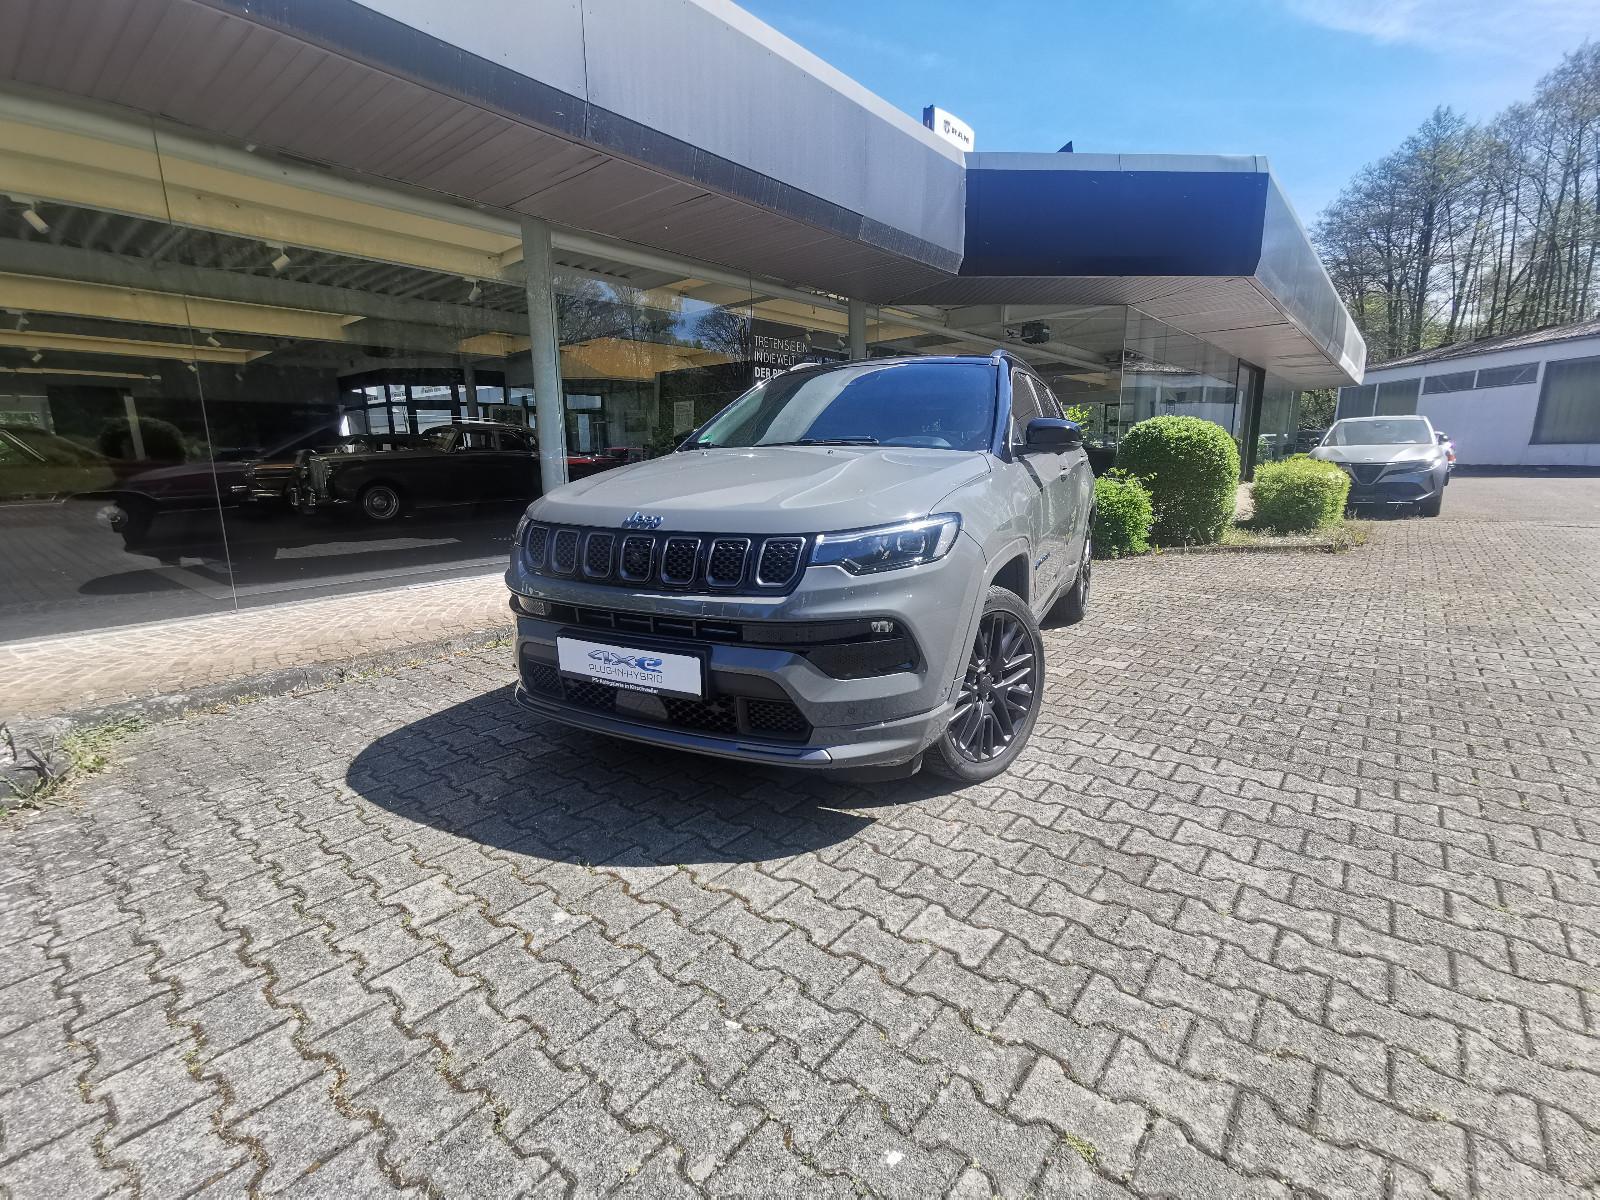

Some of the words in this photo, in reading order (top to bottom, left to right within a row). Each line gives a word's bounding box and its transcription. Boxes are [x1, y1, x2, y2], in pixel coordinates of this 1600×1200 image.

[952, 127, 969, 144] RAM
[754, 350, 763, 363] IN
[763, 352, 776, 364] DIE
[777, 354, 796, 366] WELT
[754, 366, 771, 379] DER
[621, 511, 664, 529] Jeep
